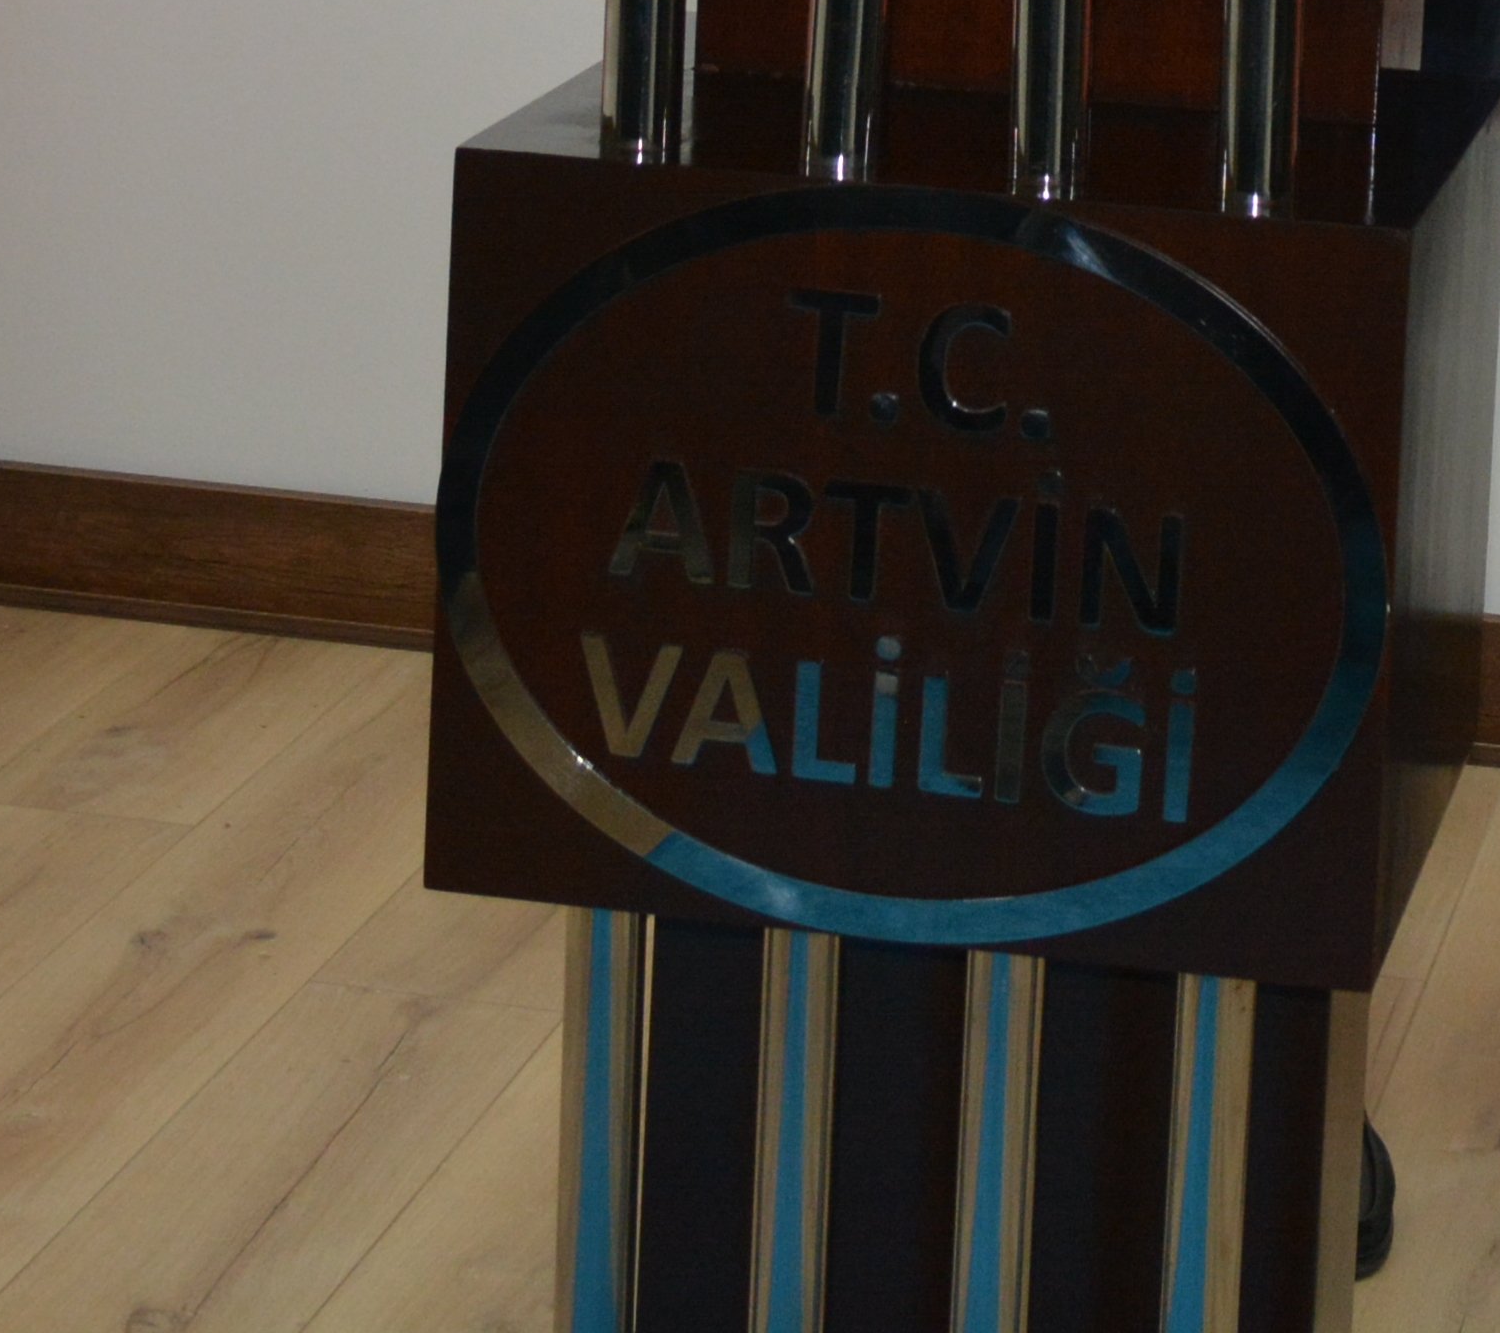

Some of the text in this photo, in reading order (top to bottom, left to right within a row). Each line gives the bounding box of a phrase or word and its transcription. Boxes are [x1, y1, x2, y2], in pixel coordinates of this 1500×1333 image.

[789, 288, 1051, 441] T.C.
[608, 459, 1185, 636] ARTVİN
[580, 633, 1197, 824] VALİLİĞİ
